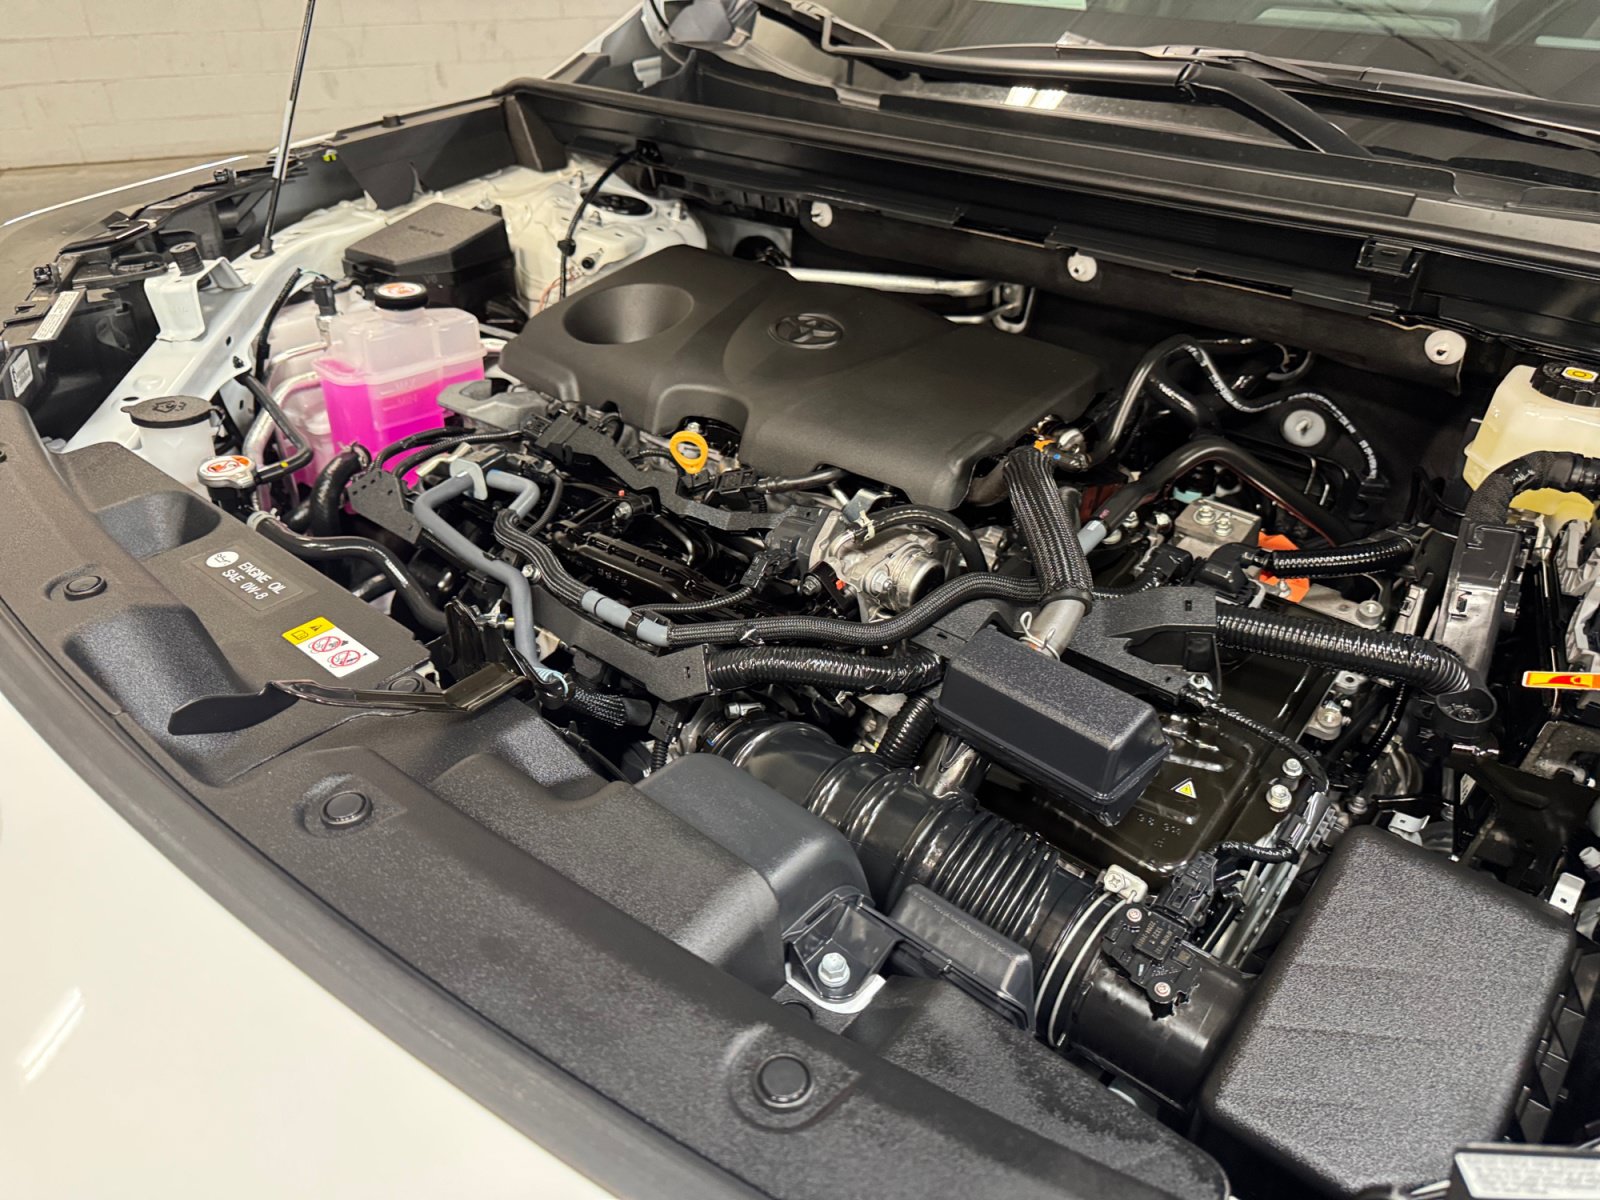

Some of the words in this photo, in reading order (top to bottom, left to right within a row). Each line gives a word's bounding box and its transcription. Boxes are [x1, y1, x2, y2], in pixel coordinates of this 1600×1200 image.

[221, 568, 246, 583] SAE
[240, 581, 269, 600] 0W-8
[237, 561, 273, 584] ENGINE
[267, 581, 287, 595] OIL
